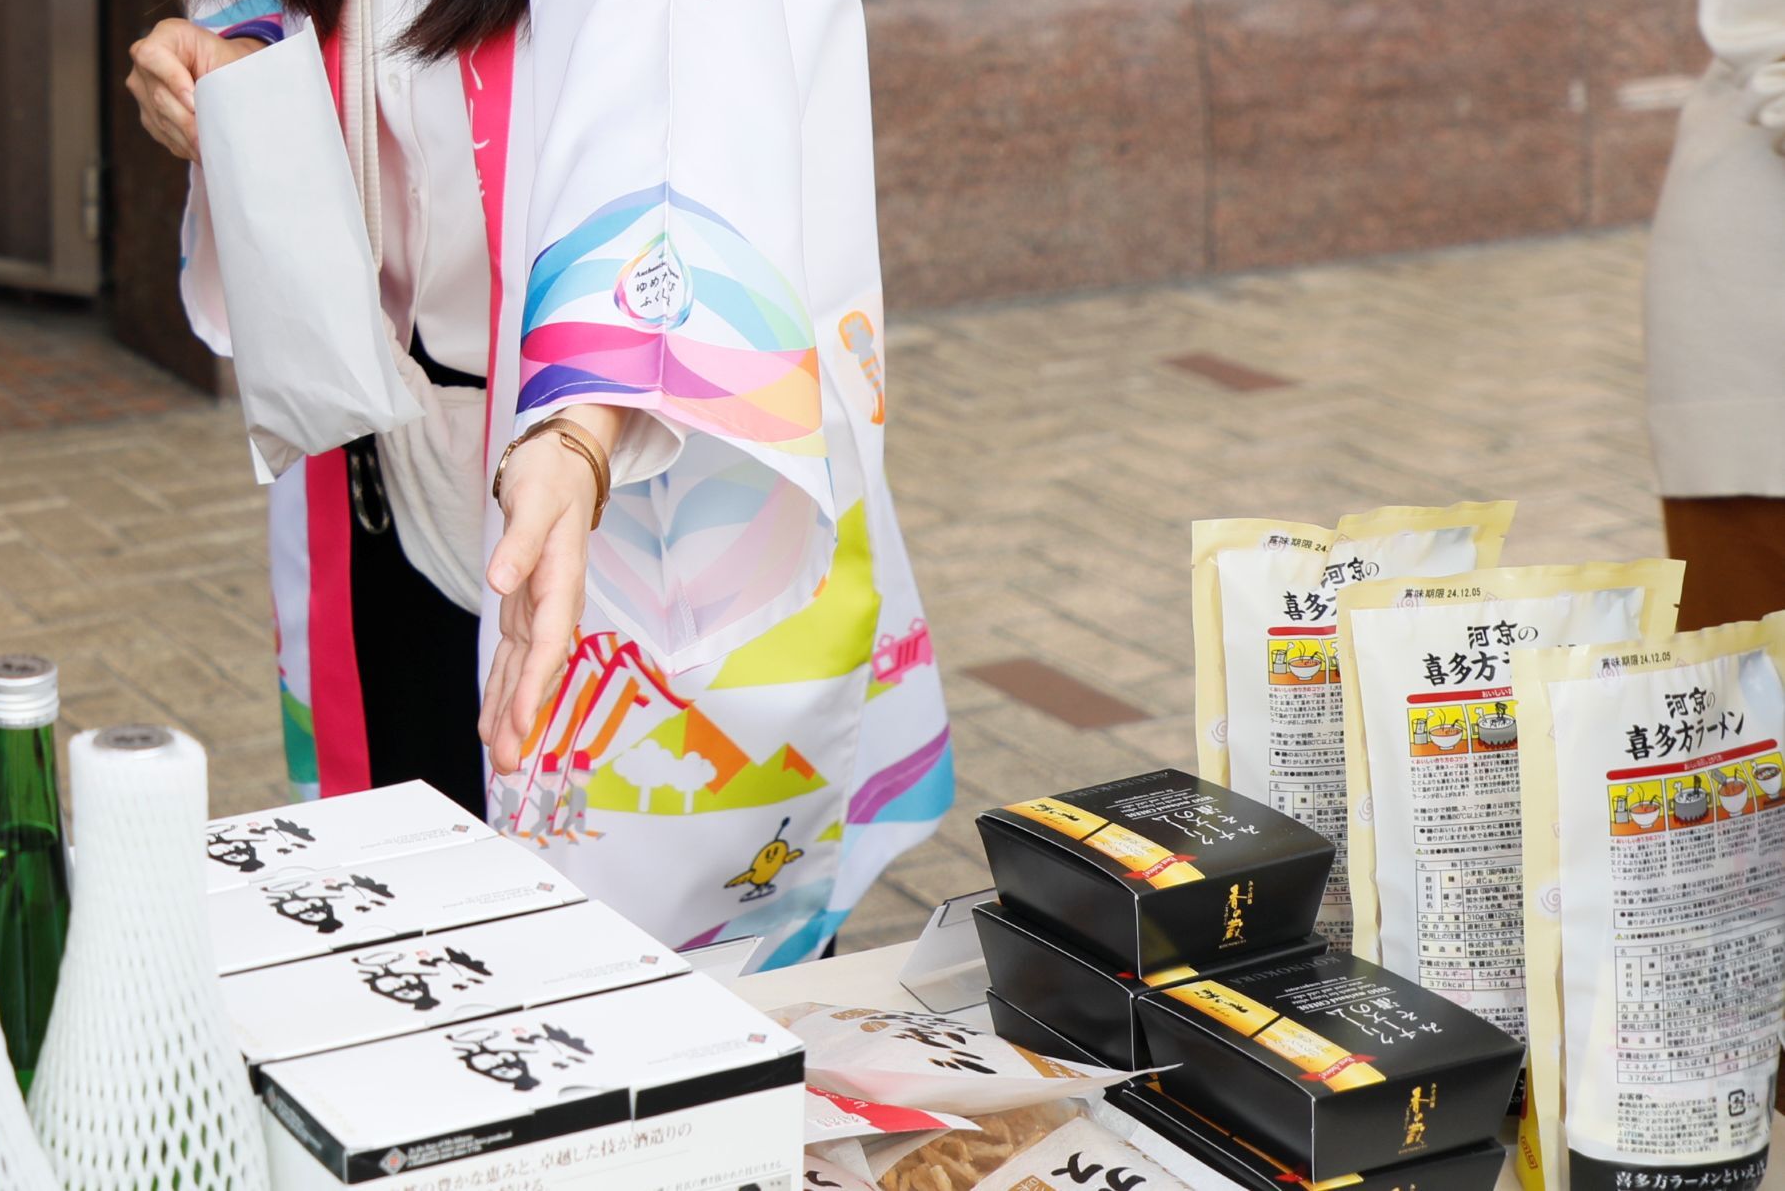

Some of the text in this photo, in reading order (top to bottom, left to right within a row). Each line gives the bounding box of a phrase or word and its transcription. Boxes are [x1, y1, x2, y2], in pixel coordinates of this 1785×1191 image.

[1321, 557, 1380, 588] 河京の
[1447, 588, 1481, 598] 24.12.05
[1467, 620, 1539, 649] 河京の
[1640, 651, 1671, 665] 24.12.05
[1665, 687, 1715, 719] 河京の
[1625, 711, 1744, 761] 喜多方ラーメン
